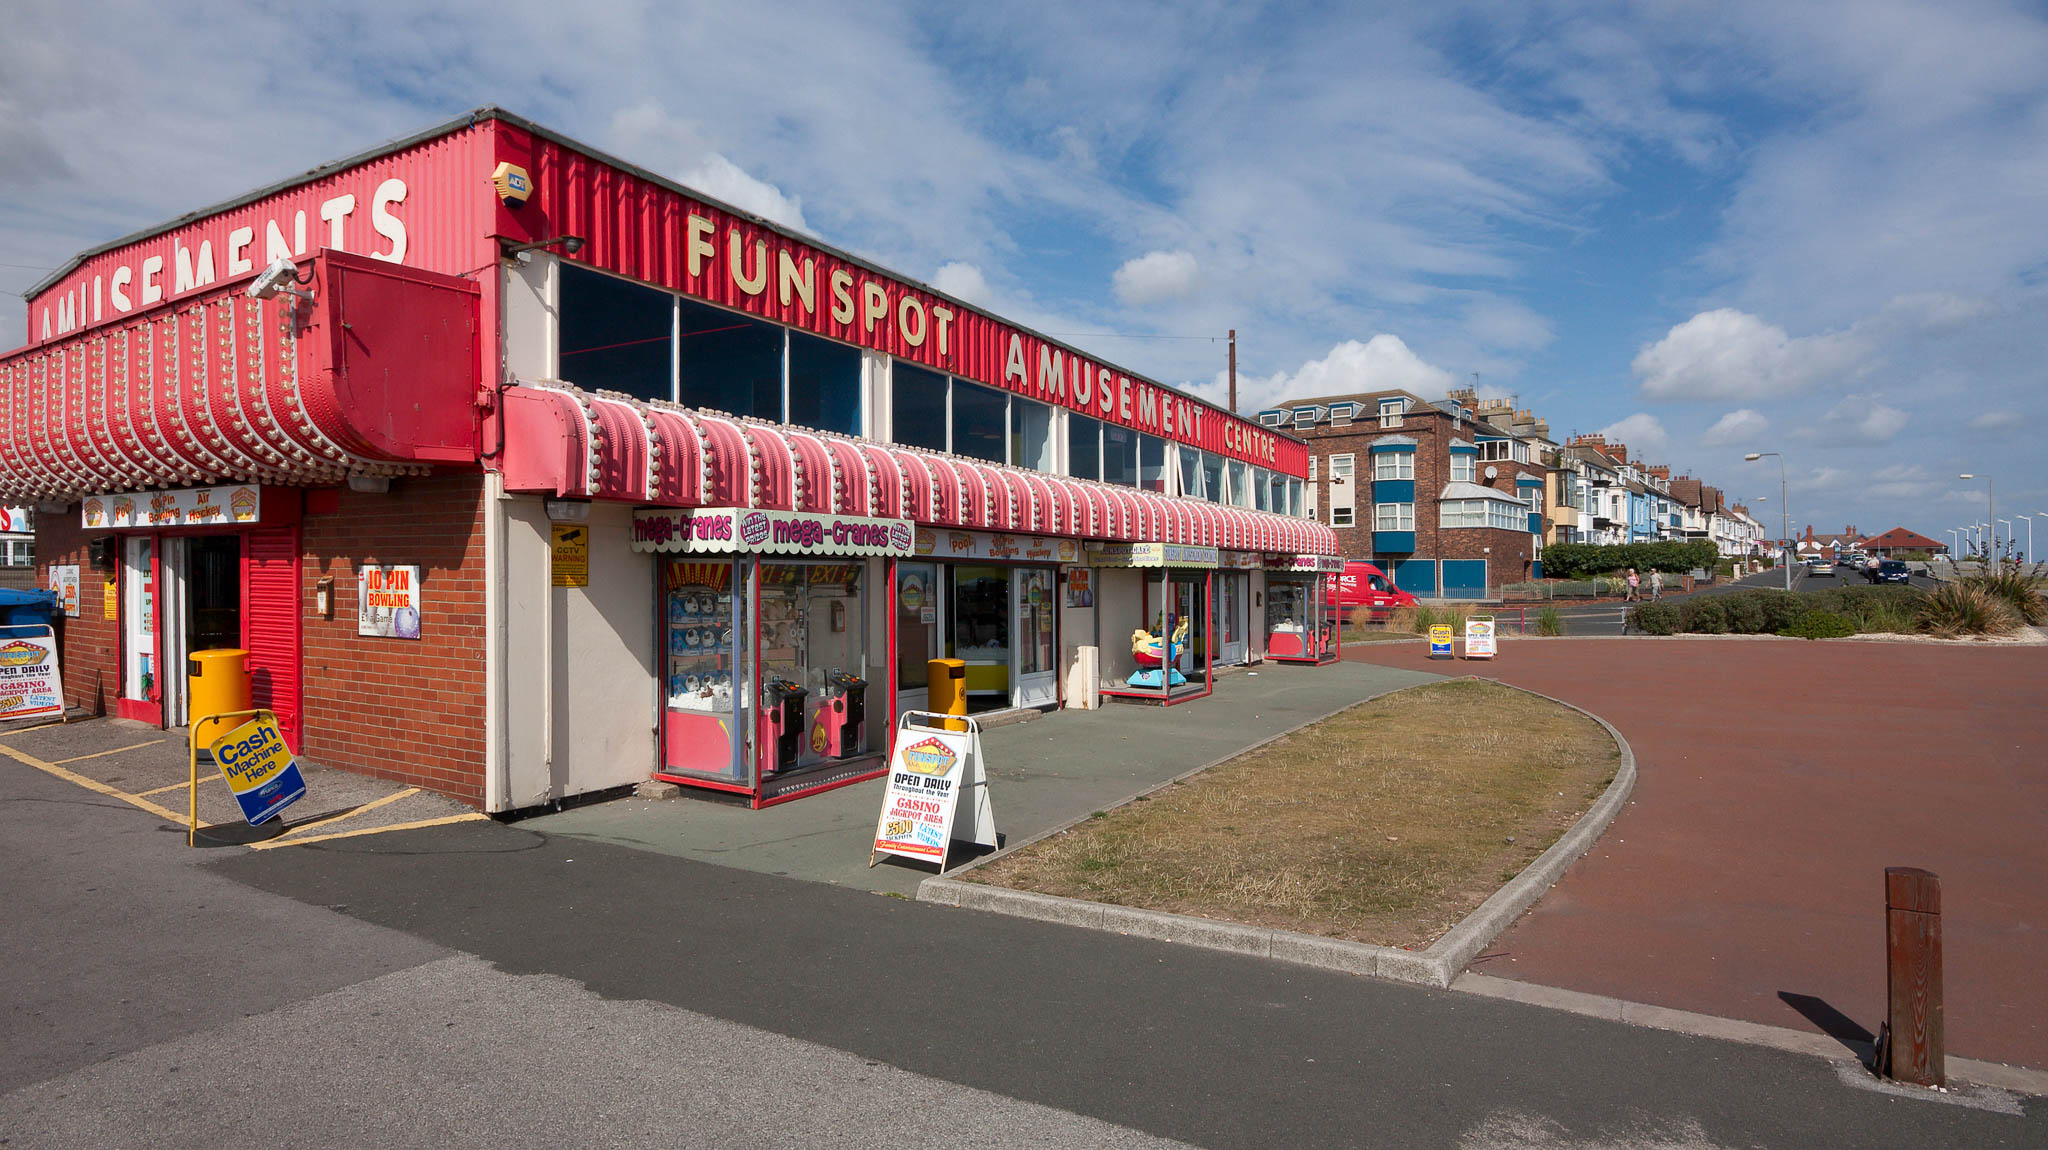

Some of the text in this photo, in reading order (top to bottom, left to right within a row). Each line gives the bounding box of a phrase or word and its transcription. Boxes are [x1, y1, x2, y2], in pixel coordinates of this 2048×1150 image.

[509, 176, 525, 190] ADT
[688, 213, 1276, 463] FUNSPOT AMUSEMENT CENTRE
[162, 495, 175, 506] Pin
[197, 491, 210, 505] Air
[115, 497, 133, 521] Pool
[149, 507, 180, 523] Bowling
[189, 504, 221, 521] Hockey
[557, 546, 580, 554] CCTV
[952, 534, 971, 552] Pool
[552, 554, 585, 562] WARNING
[989, 547, 1019, 557] Bowling
[386, 570, 409, 590] PIN
[369, 593, 409, 608] BOWLING
[376, 613, 393, 623] Game
[22, 665, 50, 673] DAILY
[0, 680, 46, 690] CASINO
[218, 726, 277, 765] Cash
[226, 742, 283, 778] Machine
[908, 751, 950, 766] FUNSPOT
[245, 760, 276, 783] Here
[894, 783, 924, 794] Throughout
[895, 773, 951, 791] OPEN DAILY
[897, 798, 940, 813] CASINO
[890, 808, 943, 824] JACKPOT AREA
[886, 820, 943, 840] £500 LATEST
[917, 832, 939, 848] VIDEOS
